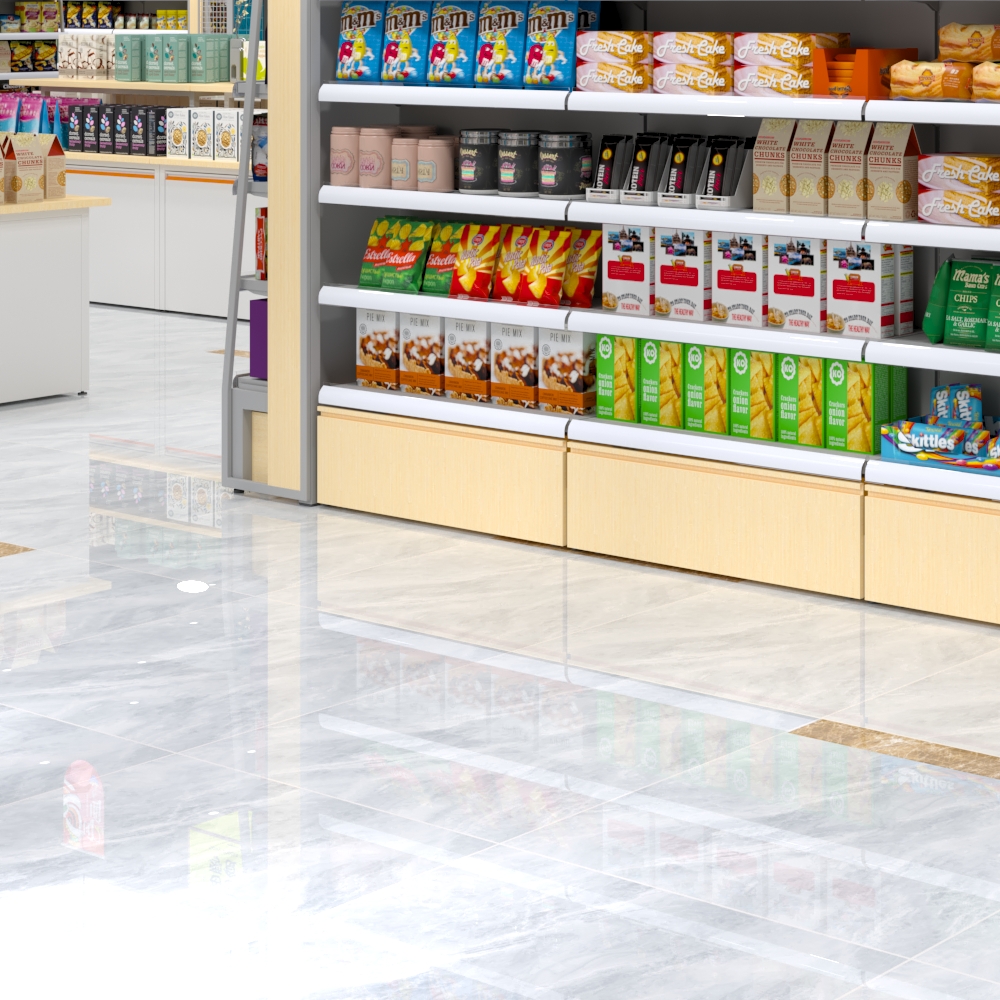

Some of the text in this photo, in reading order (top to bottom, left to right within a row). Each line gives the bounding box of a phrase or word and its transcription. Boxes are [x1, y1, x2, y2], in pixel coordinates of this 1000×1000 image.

[738, 40, 810, 62] Fresh Cake
[738, 72, 810, 92] Fresh Cake
[386, 252, 416, 264] Estrella
[953, 269, 990, 284] Mama's
[954, 294, 978, 303] CHIPS
[410, 318, 429, 327] PIE MIX
[456, 323, 475, 333] PIE MIX
[502, 328, 522, 338] PIE MIX
[550, 333, 571, 343] PIE MIX
[646, 348, 656, 358] KO
[690, 353, 700, 362] KO
[735, 358, 746, 367] KO
[783, 363, 794, 373] KO
[598, 387, 613, 397] flavor
[643, 385, 657, 395] onion
[687, 390, 702, 400] onion
[643, 392, 657, 403] flavor
[781, 401, 796, 411] onion
[780, 409, 796, 420] flavor
[829, 407, 845, 417] onion
[828, 415, 845, 426] flavor
